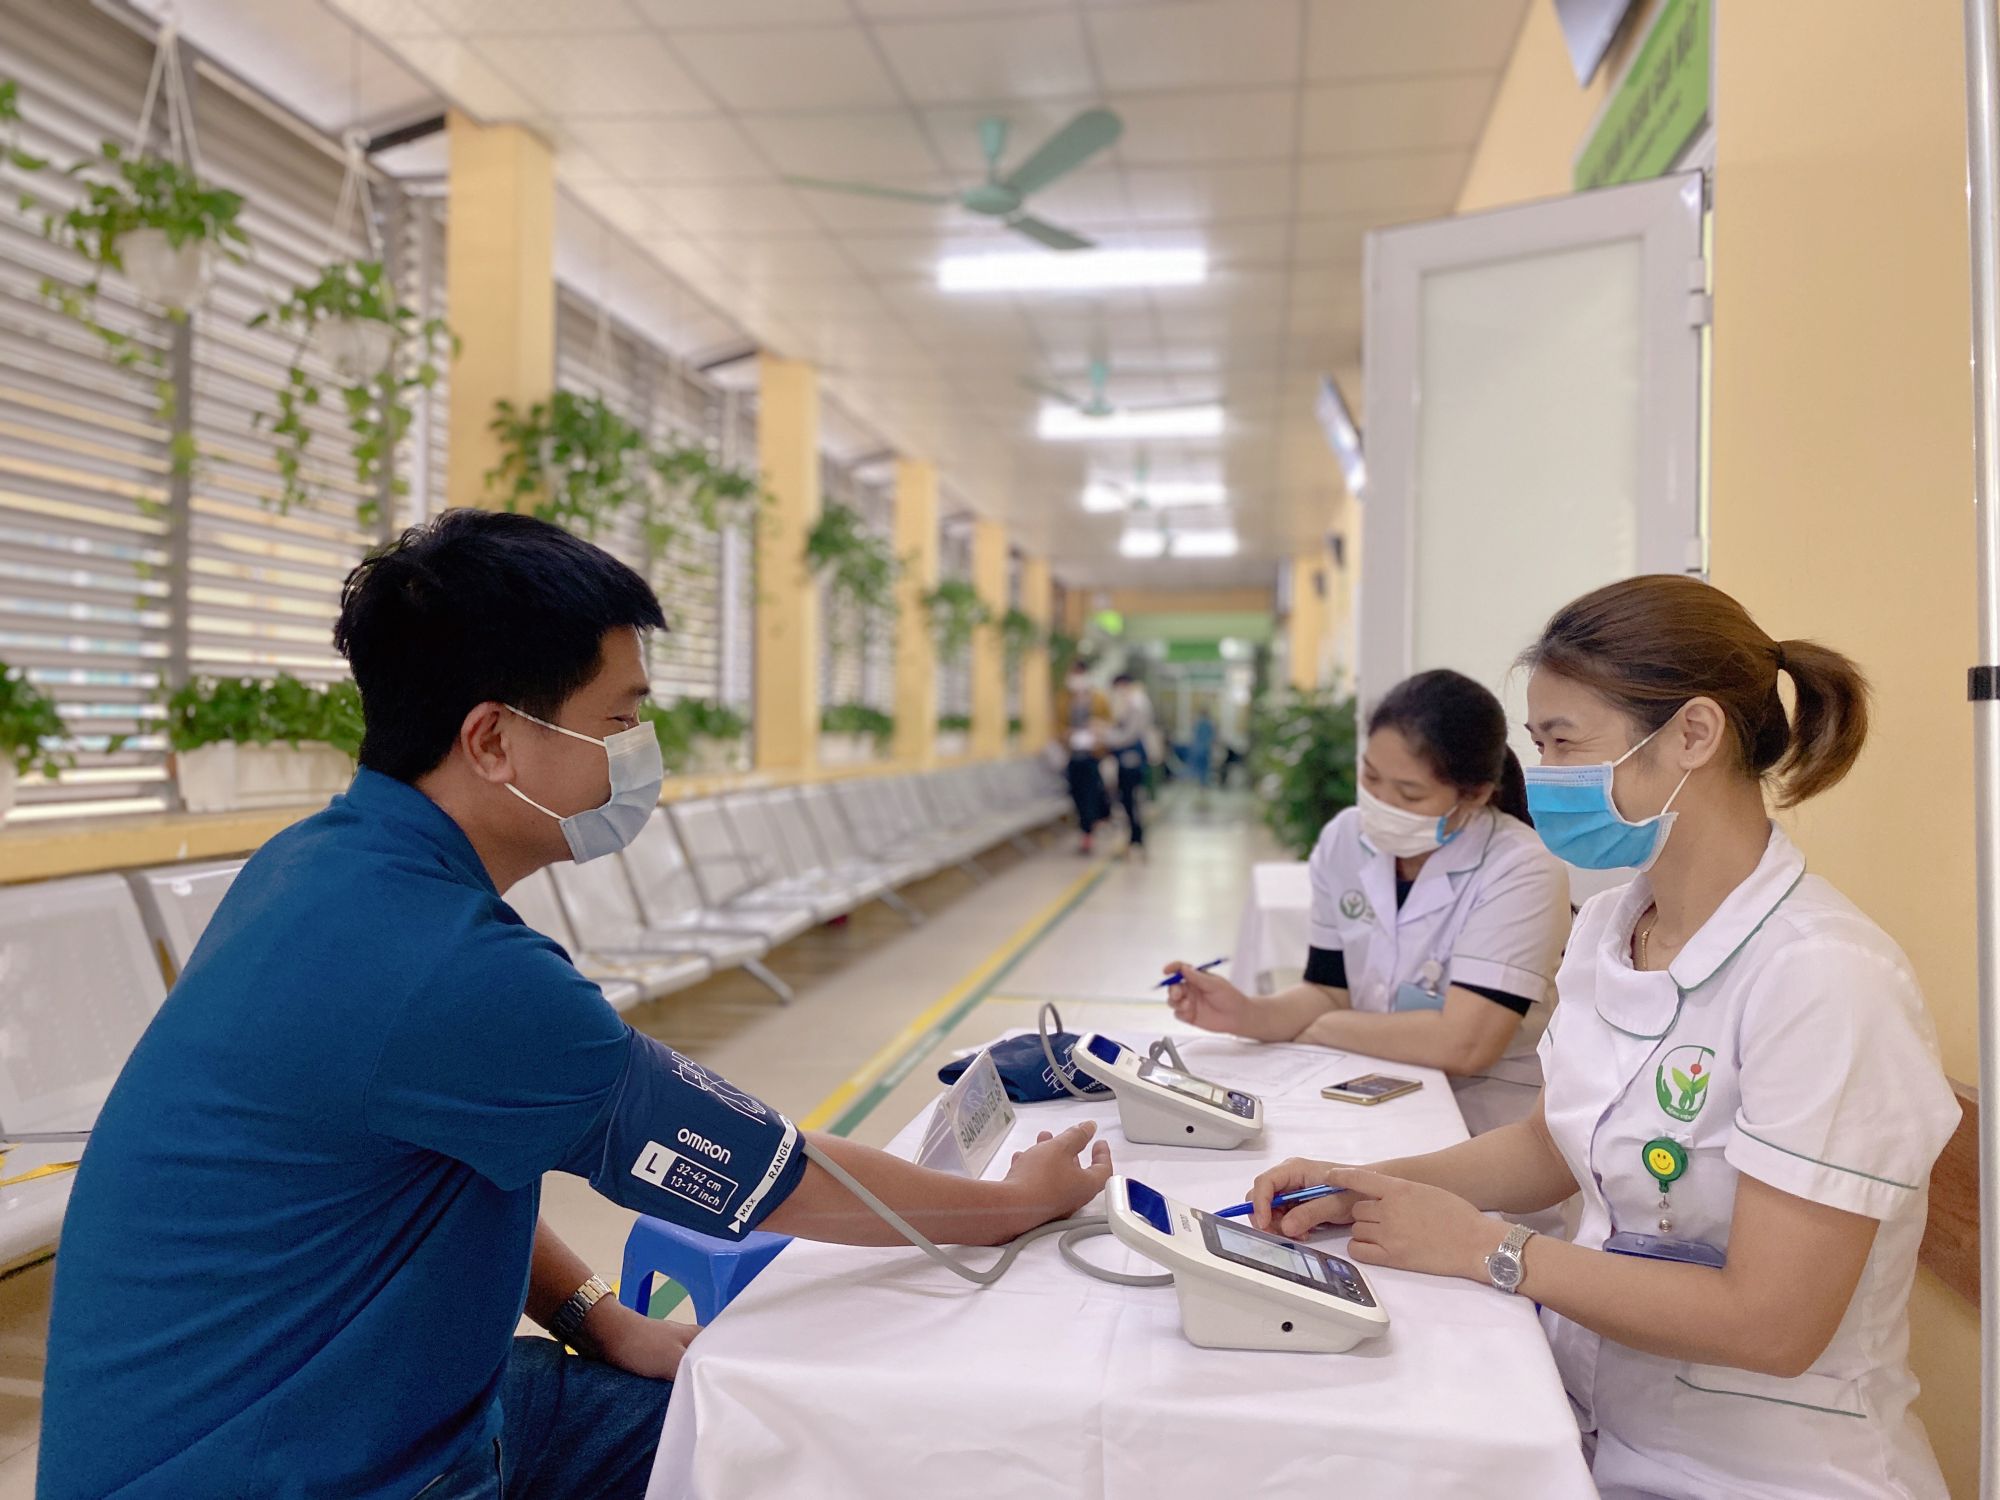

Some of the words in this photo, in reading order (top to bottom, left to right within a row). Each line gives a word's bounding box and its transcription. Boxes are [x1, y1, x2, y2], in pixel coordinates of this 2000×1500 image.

[677, 1128, 731, 1165] OMRON
[645, 1152, 657, 1175] L
[676, 1163, 706, 1184] 32-42
[706, 1180, 722, 1192] cm
[740, 1198, 757, 1218] MAX
[768, 1140, 791, 1180] RANGE
[670, 1175, 699, 1195] 13-17
[698, 1187, 721, 1206] inch
